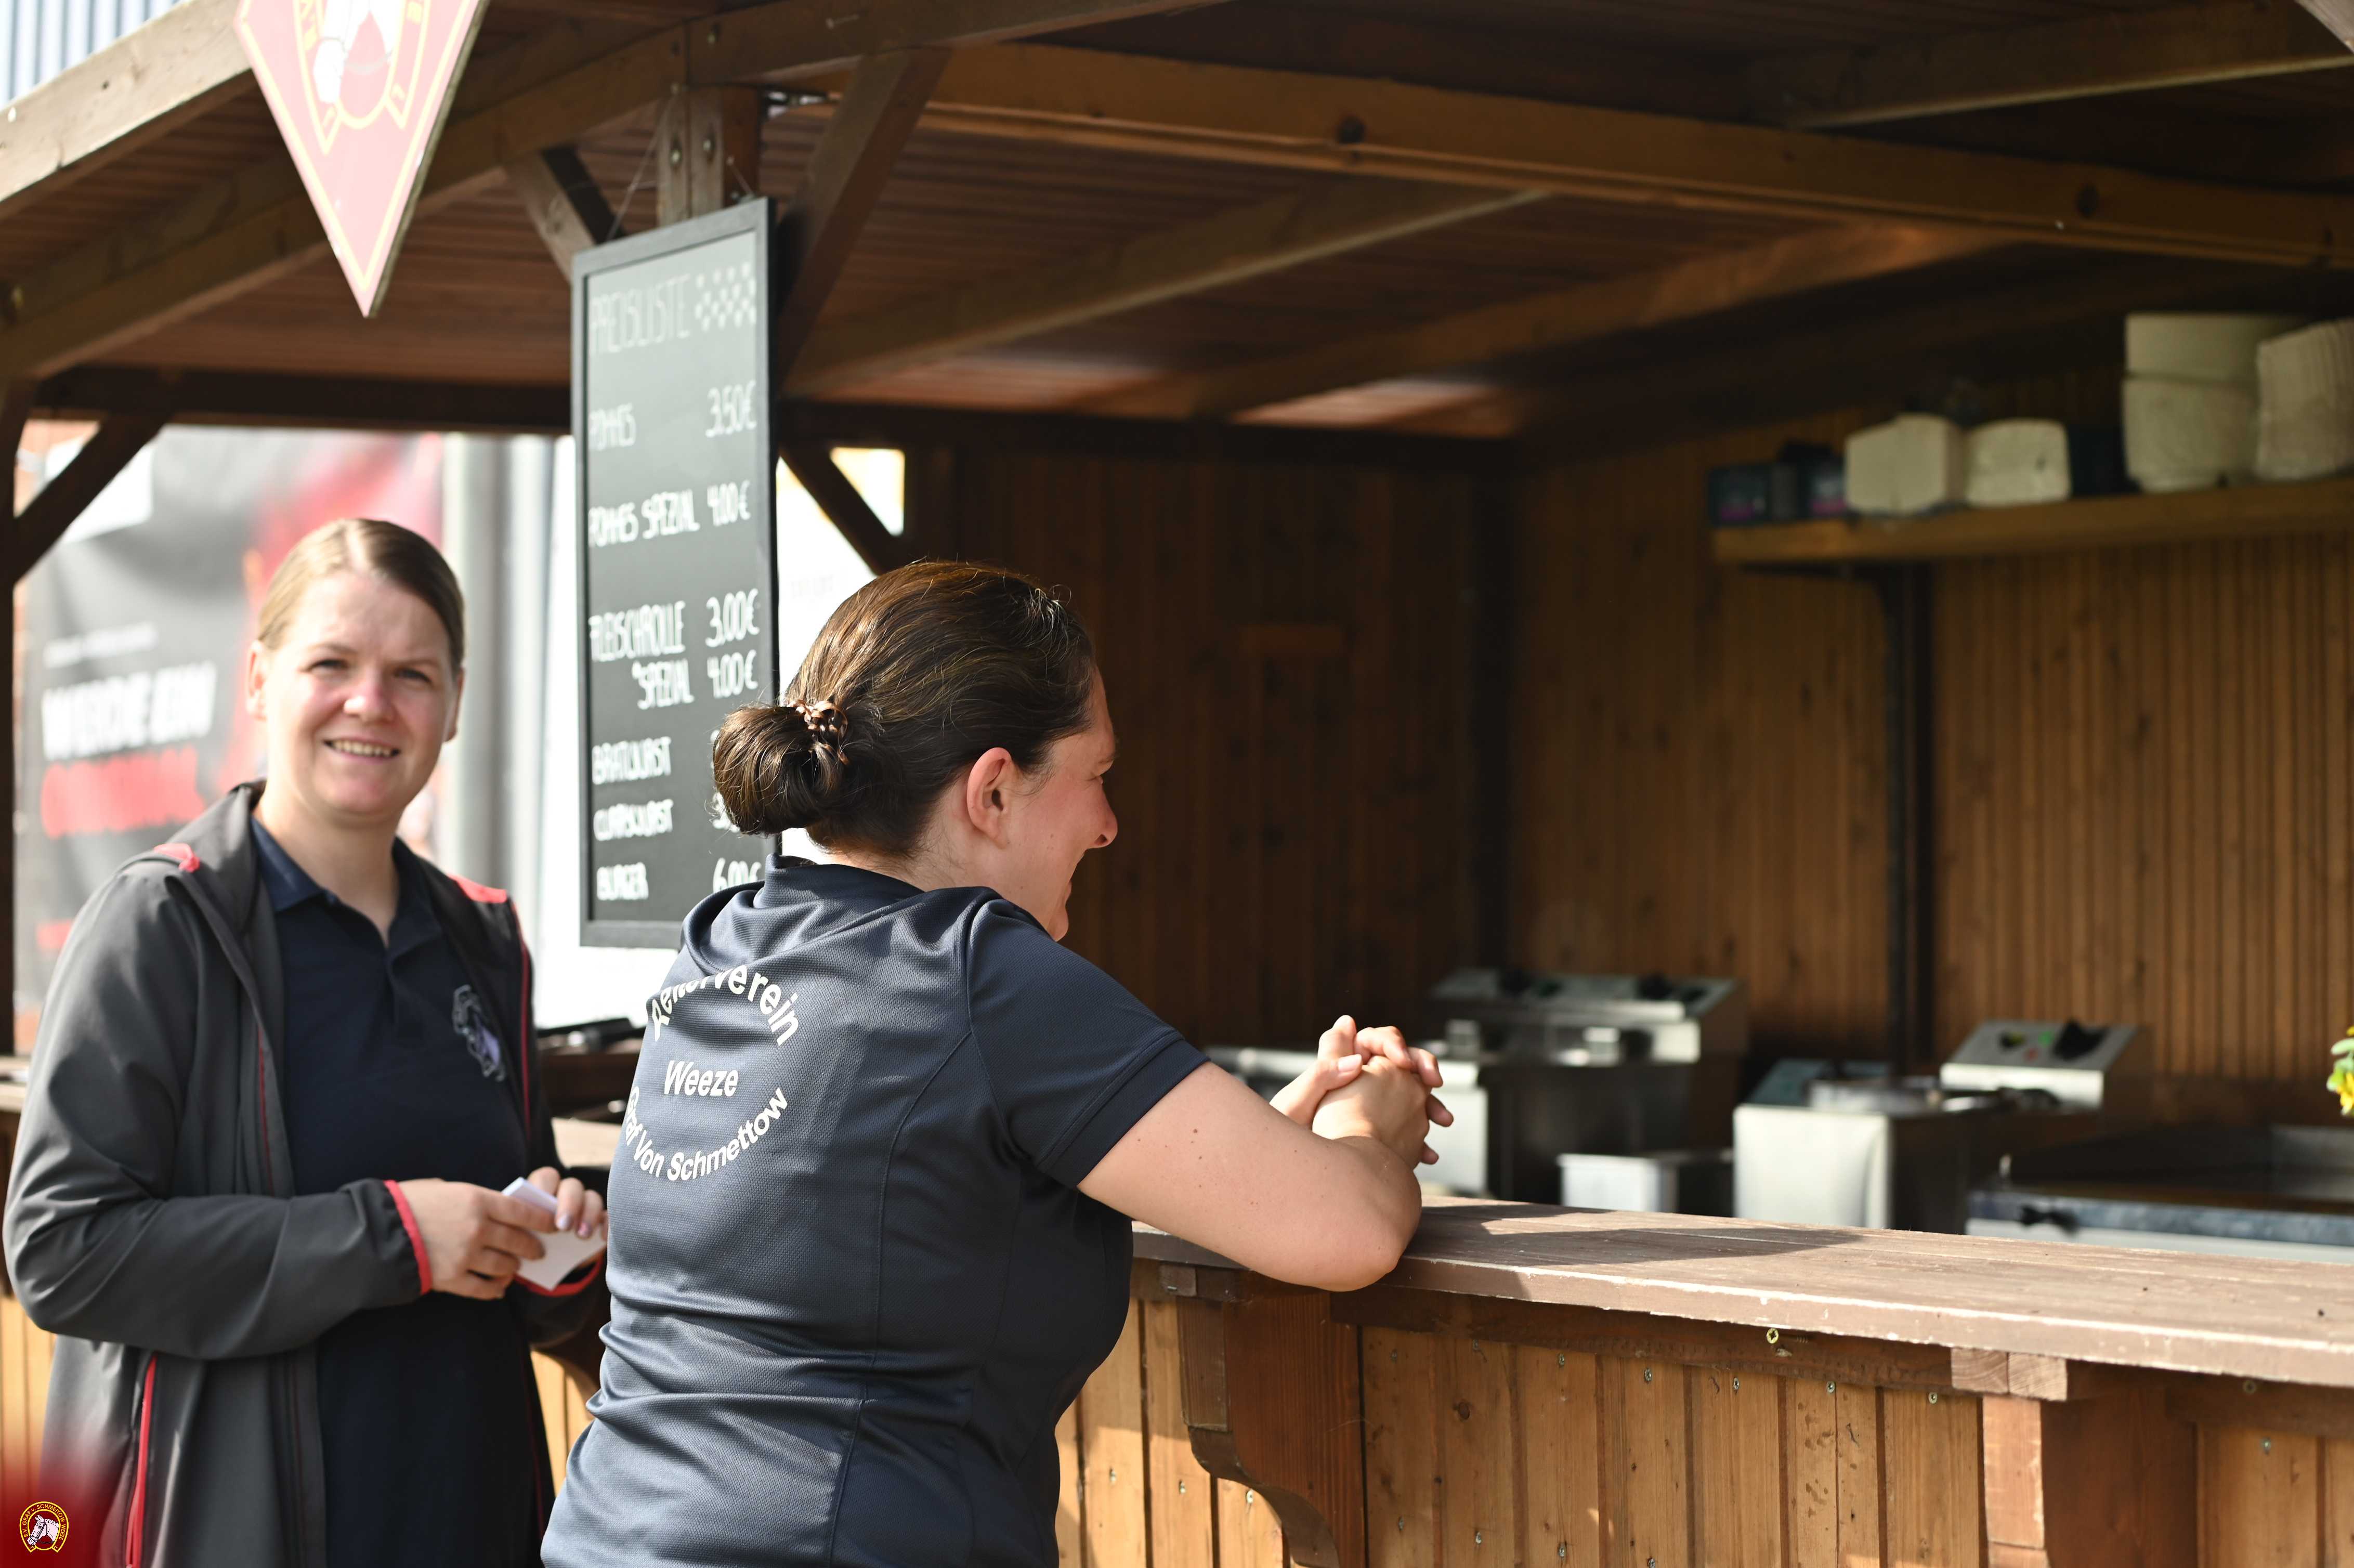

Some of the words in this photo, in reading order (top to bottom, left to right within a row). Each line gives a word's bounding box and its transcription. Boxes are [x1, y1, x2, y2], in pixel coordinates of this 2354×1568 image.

[642, 489, 700, 539] SPEZIAL
[705, 588, 760, 647] 3.00€
[707, 649, 758, 698] 4.00€
[664, 1060, 738, 1096] Weeze
[634, 1130, 664, 1177] Von
[667, 1087, 788, 1181] Schmettow
